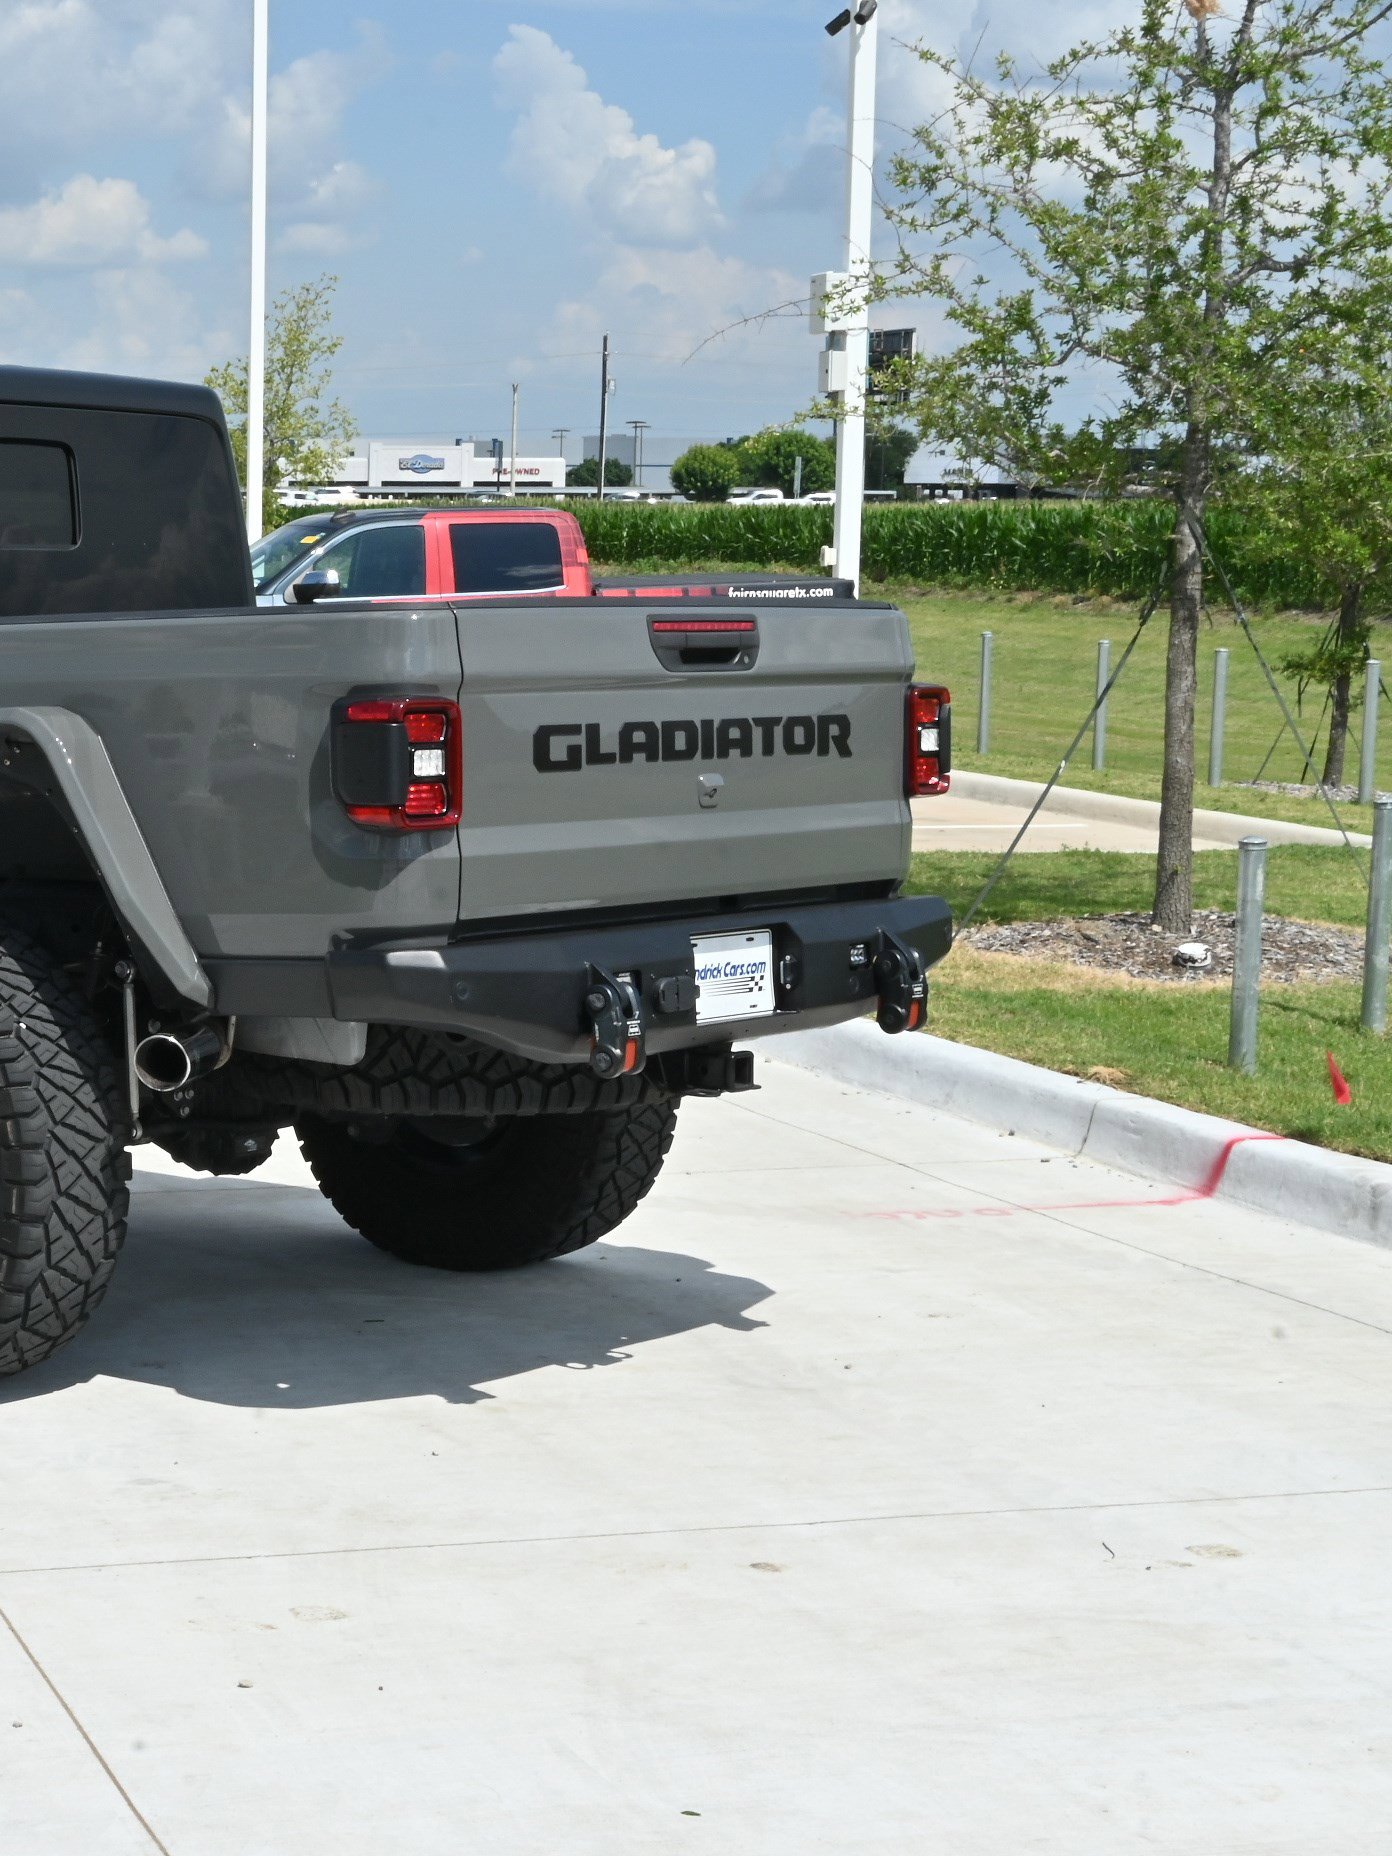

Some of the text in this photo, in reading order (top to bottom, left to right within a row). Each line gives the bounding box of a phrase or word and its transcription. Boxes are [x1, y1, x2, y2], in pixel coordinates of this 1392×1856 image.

[492, 468, 540, 476] PE-WNED
[533, 713, 853, 773] GLADIATOR
[723, 961, 767, 978] Cars.com
